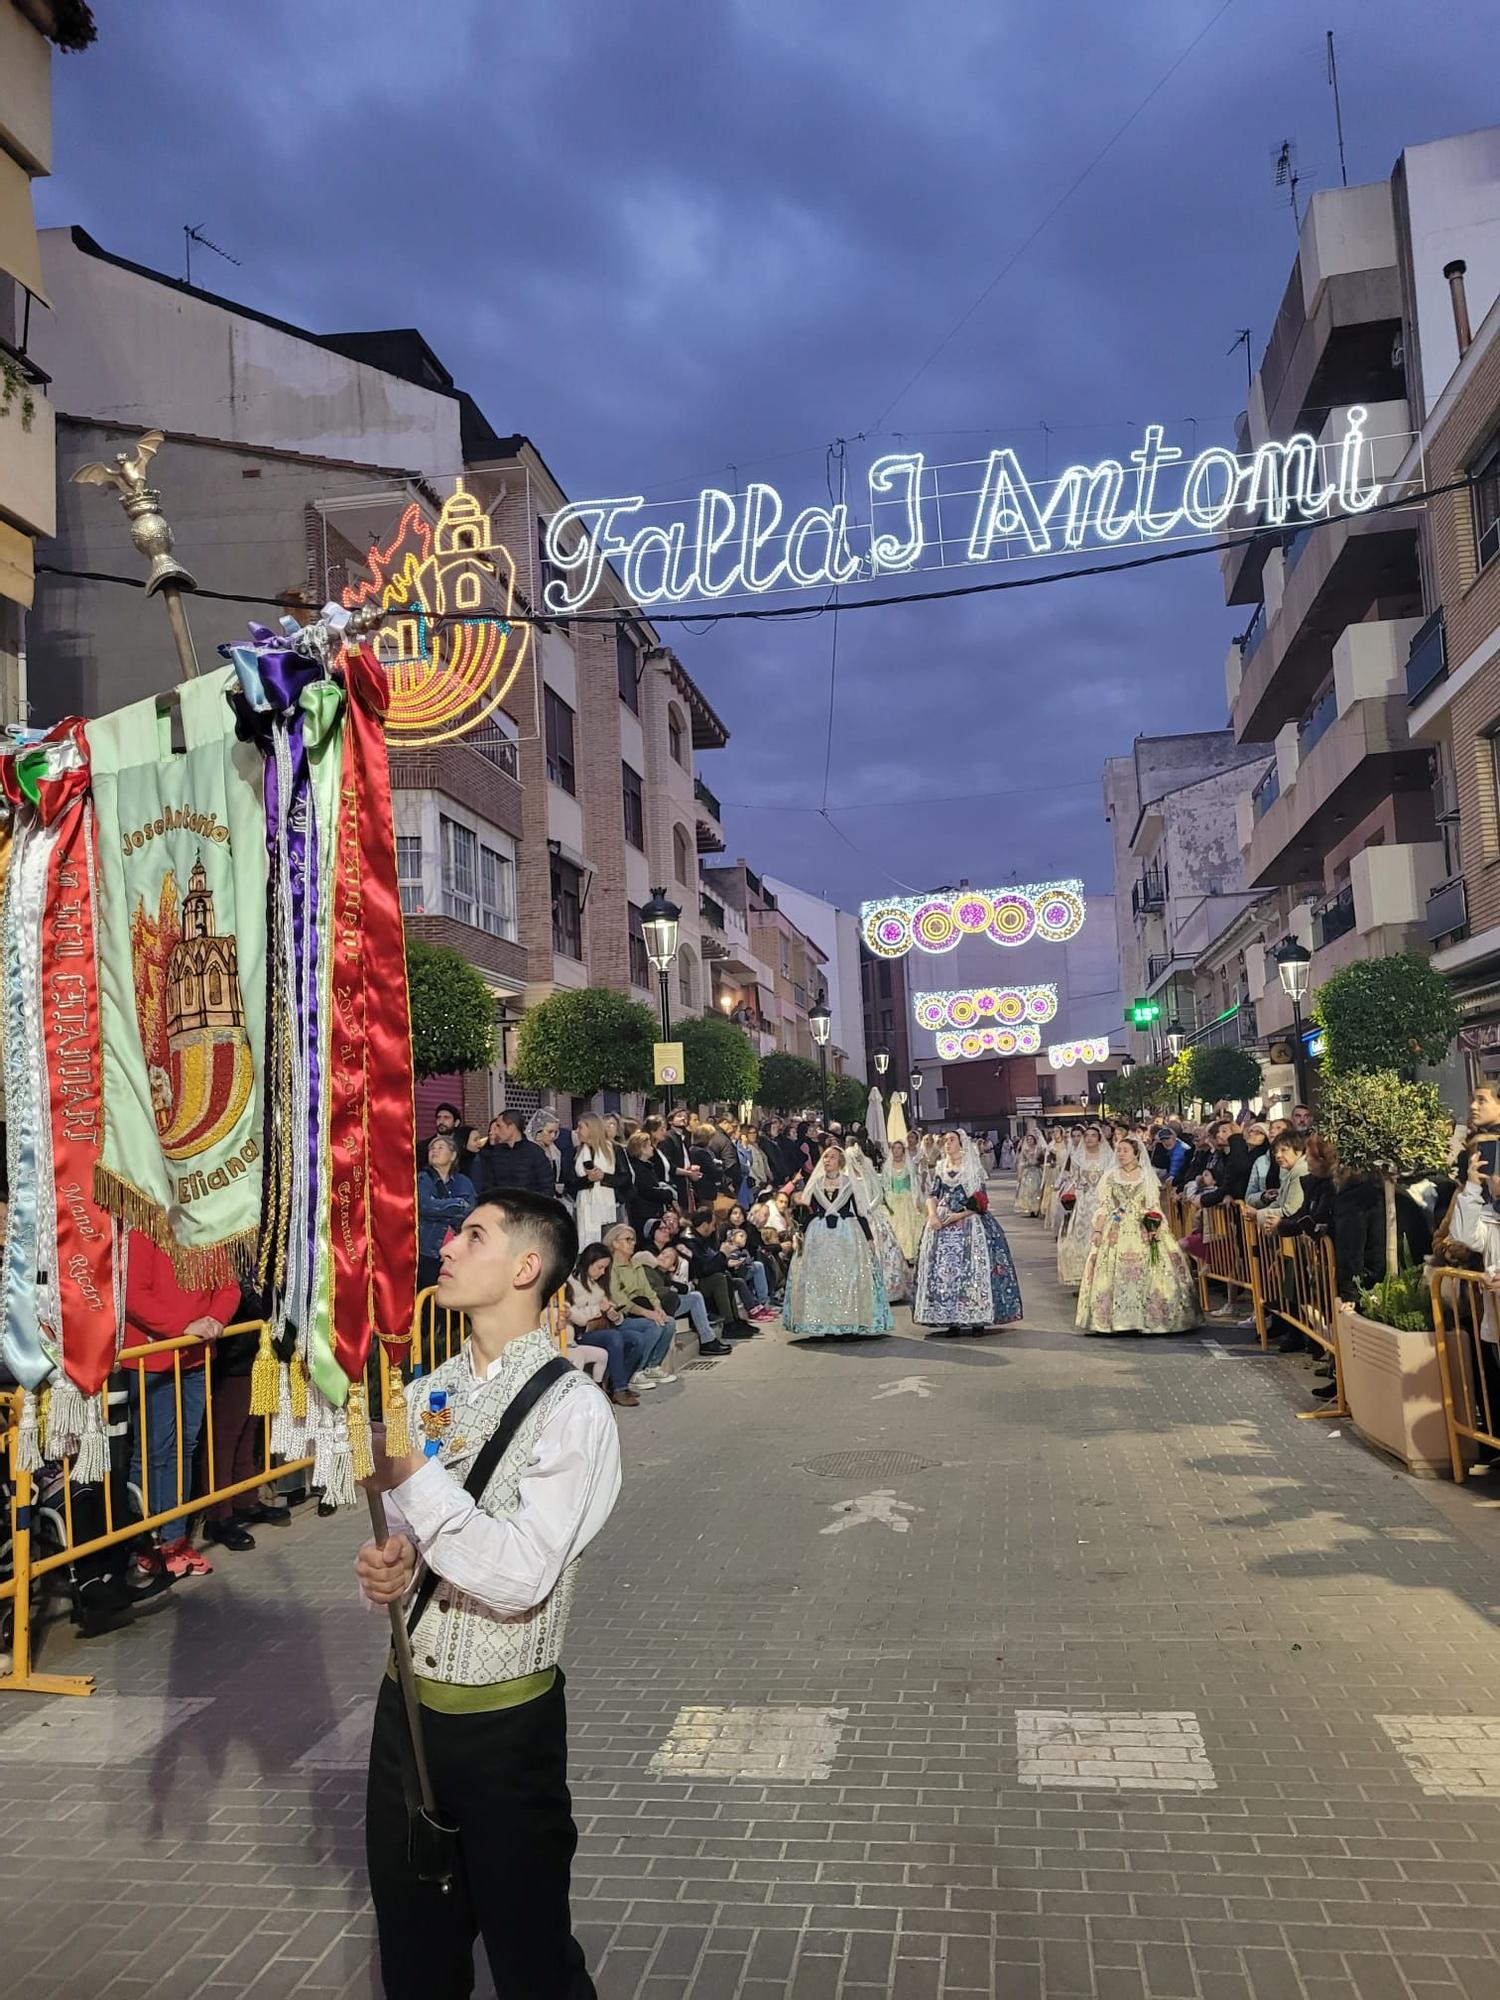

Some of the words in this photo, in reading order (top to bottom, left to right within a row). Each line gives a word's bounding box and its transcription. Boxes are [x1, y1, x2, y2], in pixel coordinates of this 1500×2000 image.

[545, 483, 860, 612] Falla
[968, 405, 1383, 560] Antoni
[178, 1138, 260, 1204] Eliana
[60, 1182, 105, 1243] Manel
[68, 1254, 104, 1312] Ricart
